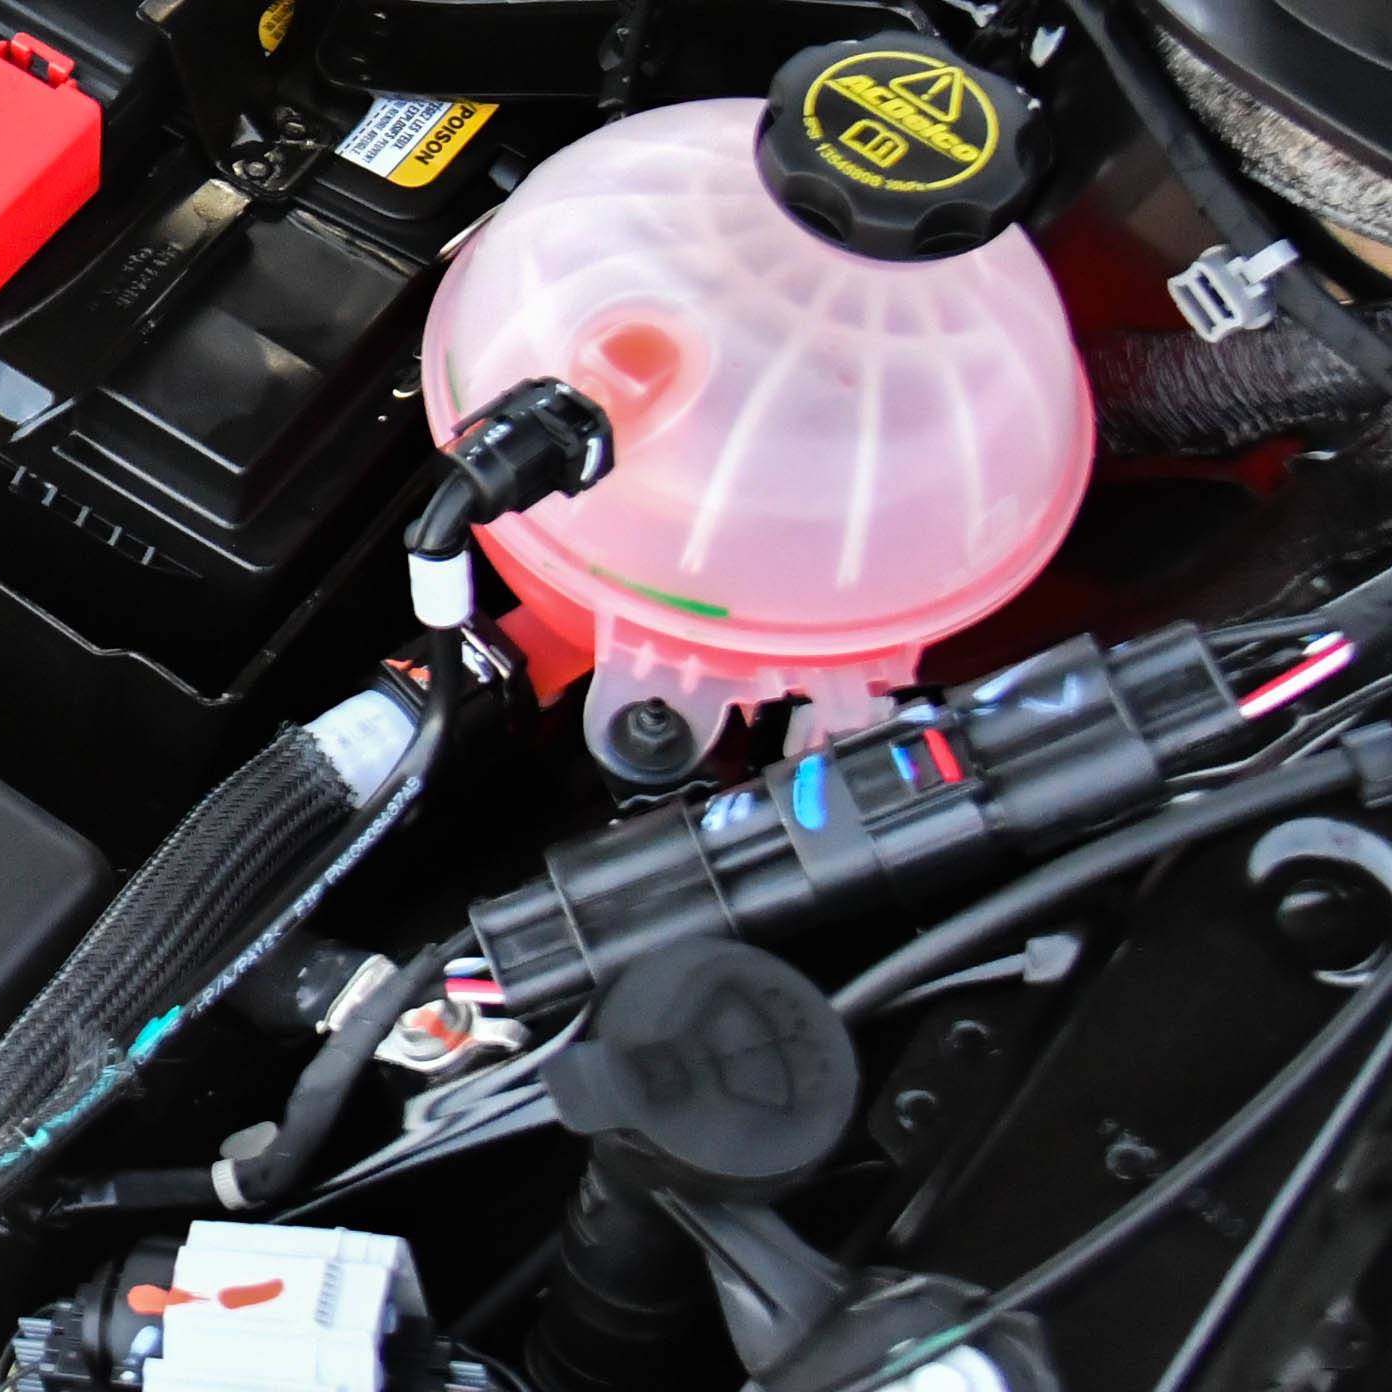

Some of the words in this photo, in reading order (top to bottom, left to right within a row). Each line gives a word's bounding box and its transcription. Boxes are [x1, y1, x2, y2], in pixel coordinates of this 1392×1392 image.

[372, 105, 399, 132] RENDRE
[383, 103, 420, 141] EXPLOSIFS
[407, 117, 425, 133] LES
[839, 73, 983, 163] ACDelco
[360, 136, 390, 165] PEUVENT
